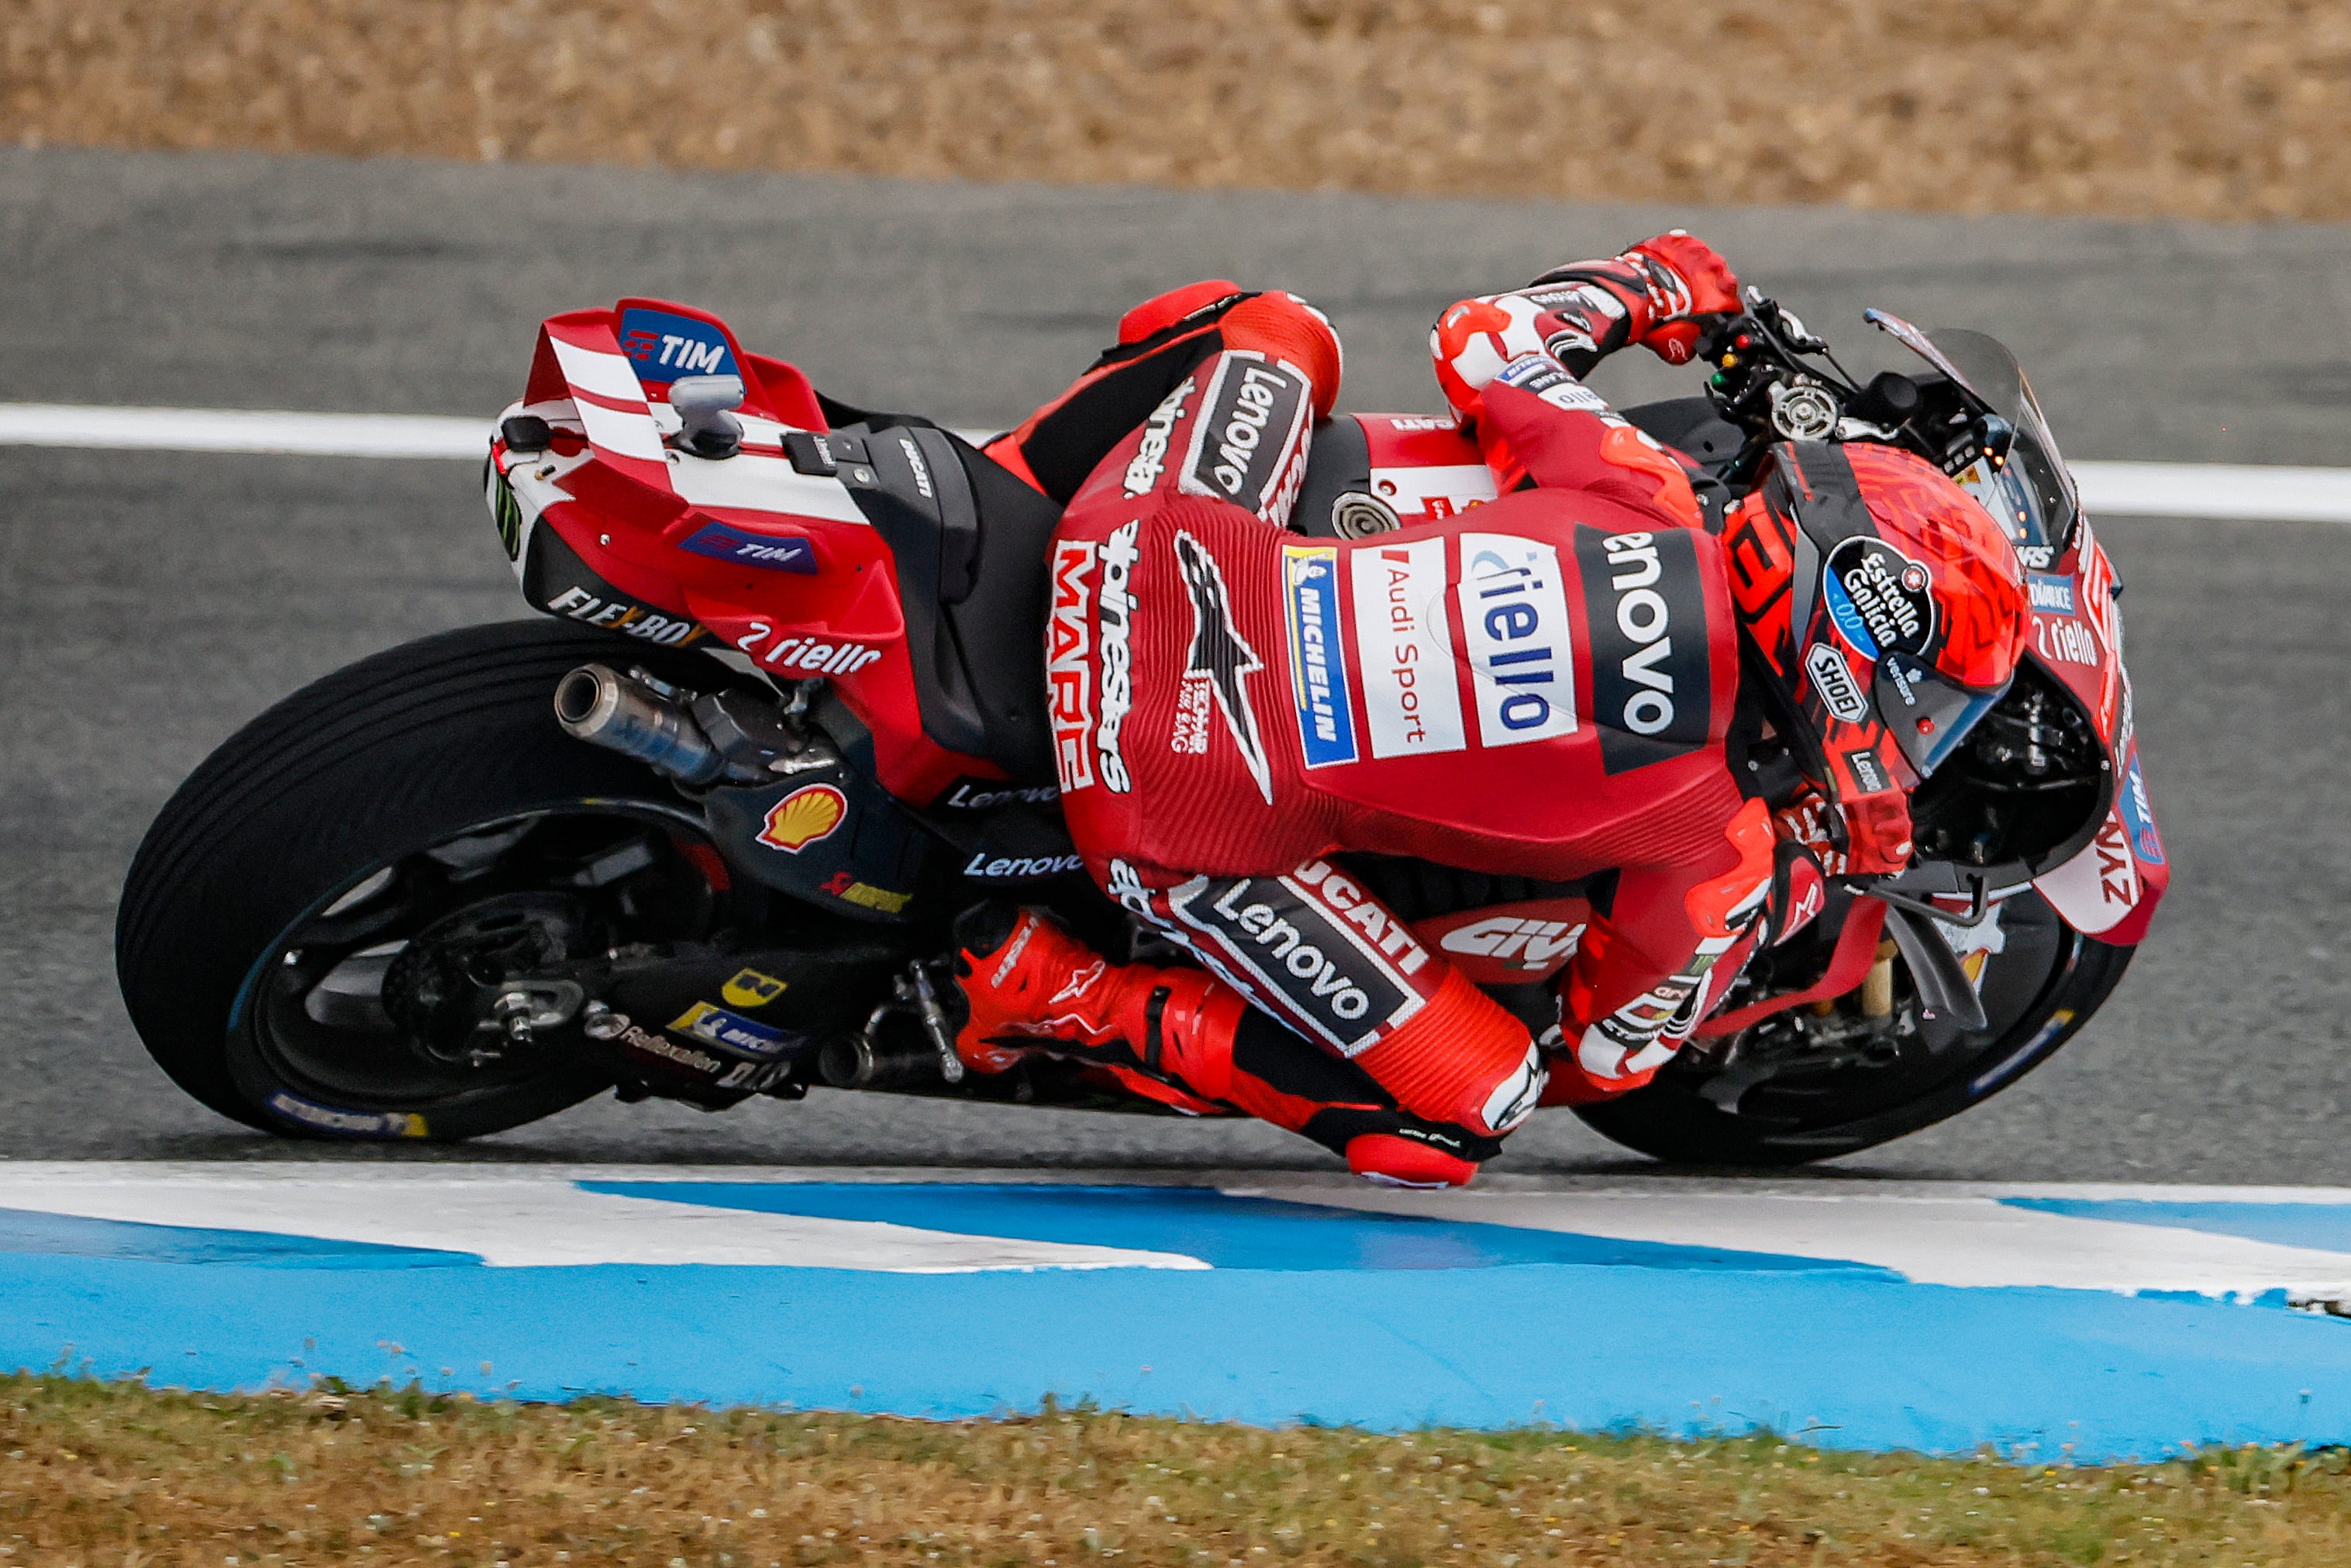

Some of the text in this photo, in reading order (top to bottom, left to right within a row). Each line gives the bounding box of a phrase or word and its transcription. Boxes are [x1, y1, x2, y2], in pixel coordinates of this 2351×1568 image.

[657, 334, 725, 374] TIM
[1214, 367, 1287, 496] Lenovo
[1390, 419, 1456, 430] CATI
[735, 542, 802, 563] TIM
[1861, 553, 1919, 639] Estrella
[1387, 568, 1425, 743] Audi Sport
[1480, 567, 1554, 730] riello
[1602, 532, 1675, 735] enovo
[1844, 569, 1896, 647] Galicia
[1046, 541, 1094, 793] MARC
[1301, 588, 1336, 743] MICHELIN
[1815, 656, 1859, 713] SHOEI
[1887, 657, 1916, 706] verisure
[1213, 878, 1370, 1021] Lenovo
[1294, 860, 1430, 977] UCATI
[1440, 916, 1587, 962] GIV
